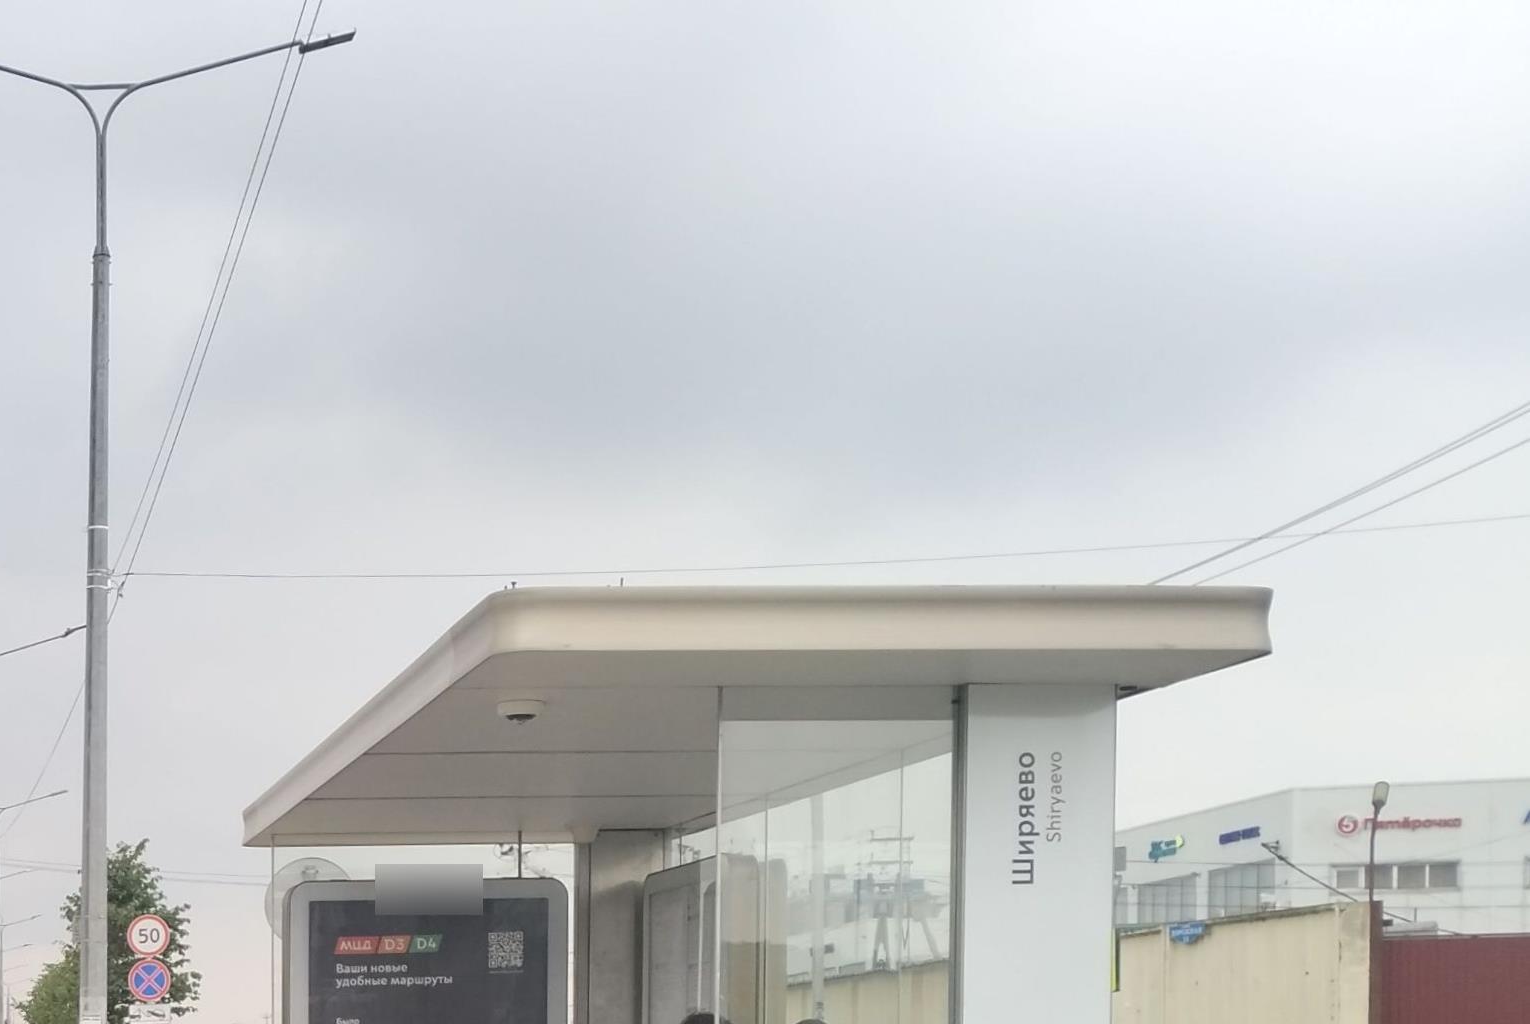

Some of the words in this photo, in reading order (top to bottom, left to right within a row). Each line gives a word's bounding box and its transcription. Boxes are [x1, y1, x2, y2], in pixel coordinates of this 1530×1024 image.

[1046, 751, 1066, 842] Shiryaevo
[1012, 752, 1040, 885] Ширяево
[138, 928, 160, 944] 50
[416, 937, 436, 950] D4
[336, 963, 368, 974] Ваши
[370, 964, 408, 973] новые
[335, 975, 388, 989] удобные
[390, 976, 453, 987] маршруты
